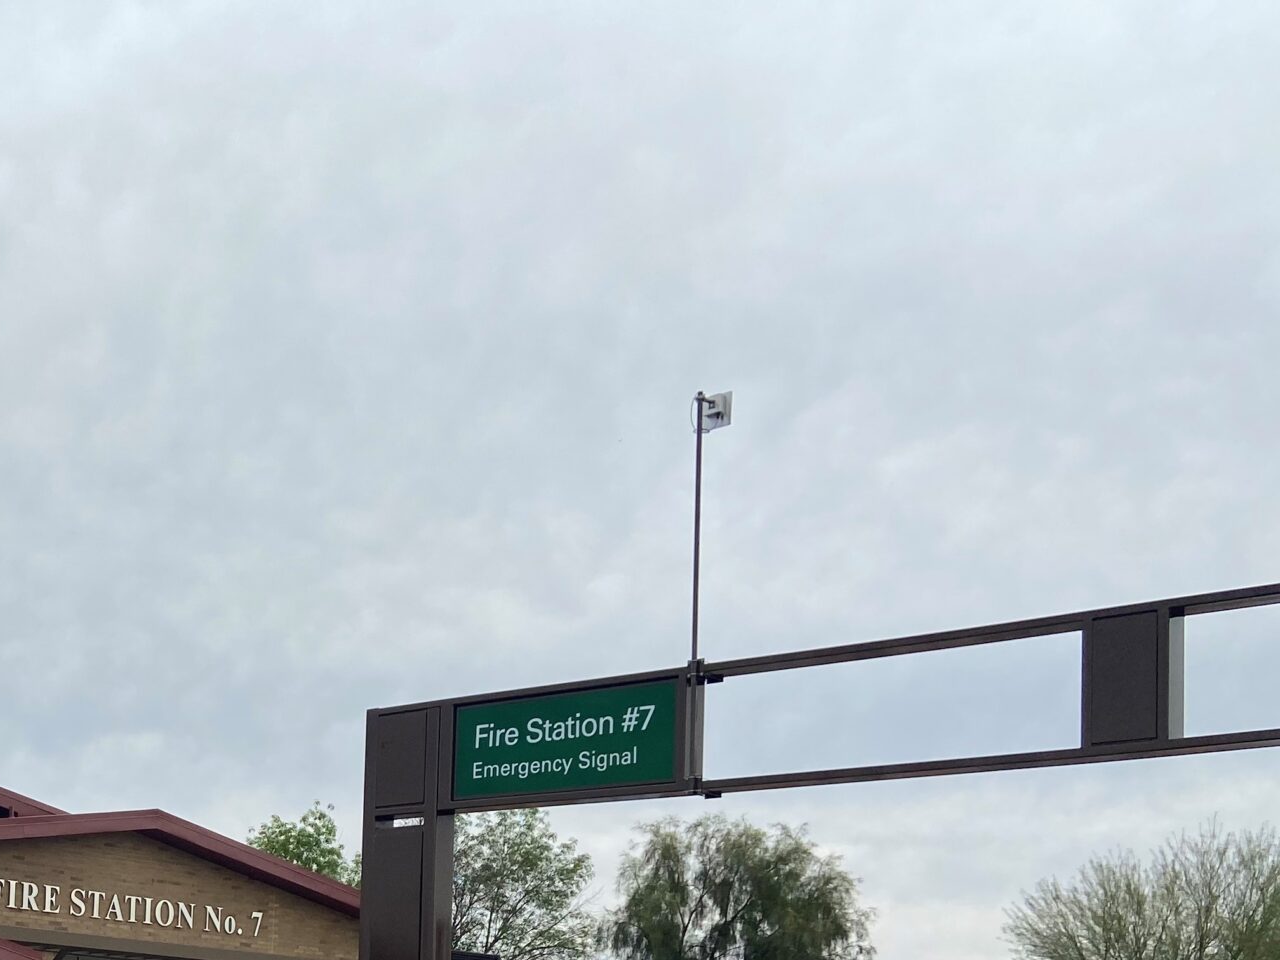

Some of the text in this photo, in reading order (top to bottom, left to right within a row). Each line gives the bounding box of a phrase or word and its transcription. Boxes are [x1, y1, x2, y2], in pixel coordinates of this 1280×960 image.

[474, 704, 656, 749] Fire Station #7
[472, 746, 638, 780] Emergency Signal
[70, 888, 197, 930] STATION
[203, 905, 244, 936] No.
[250, 911, 265, 938] 7
